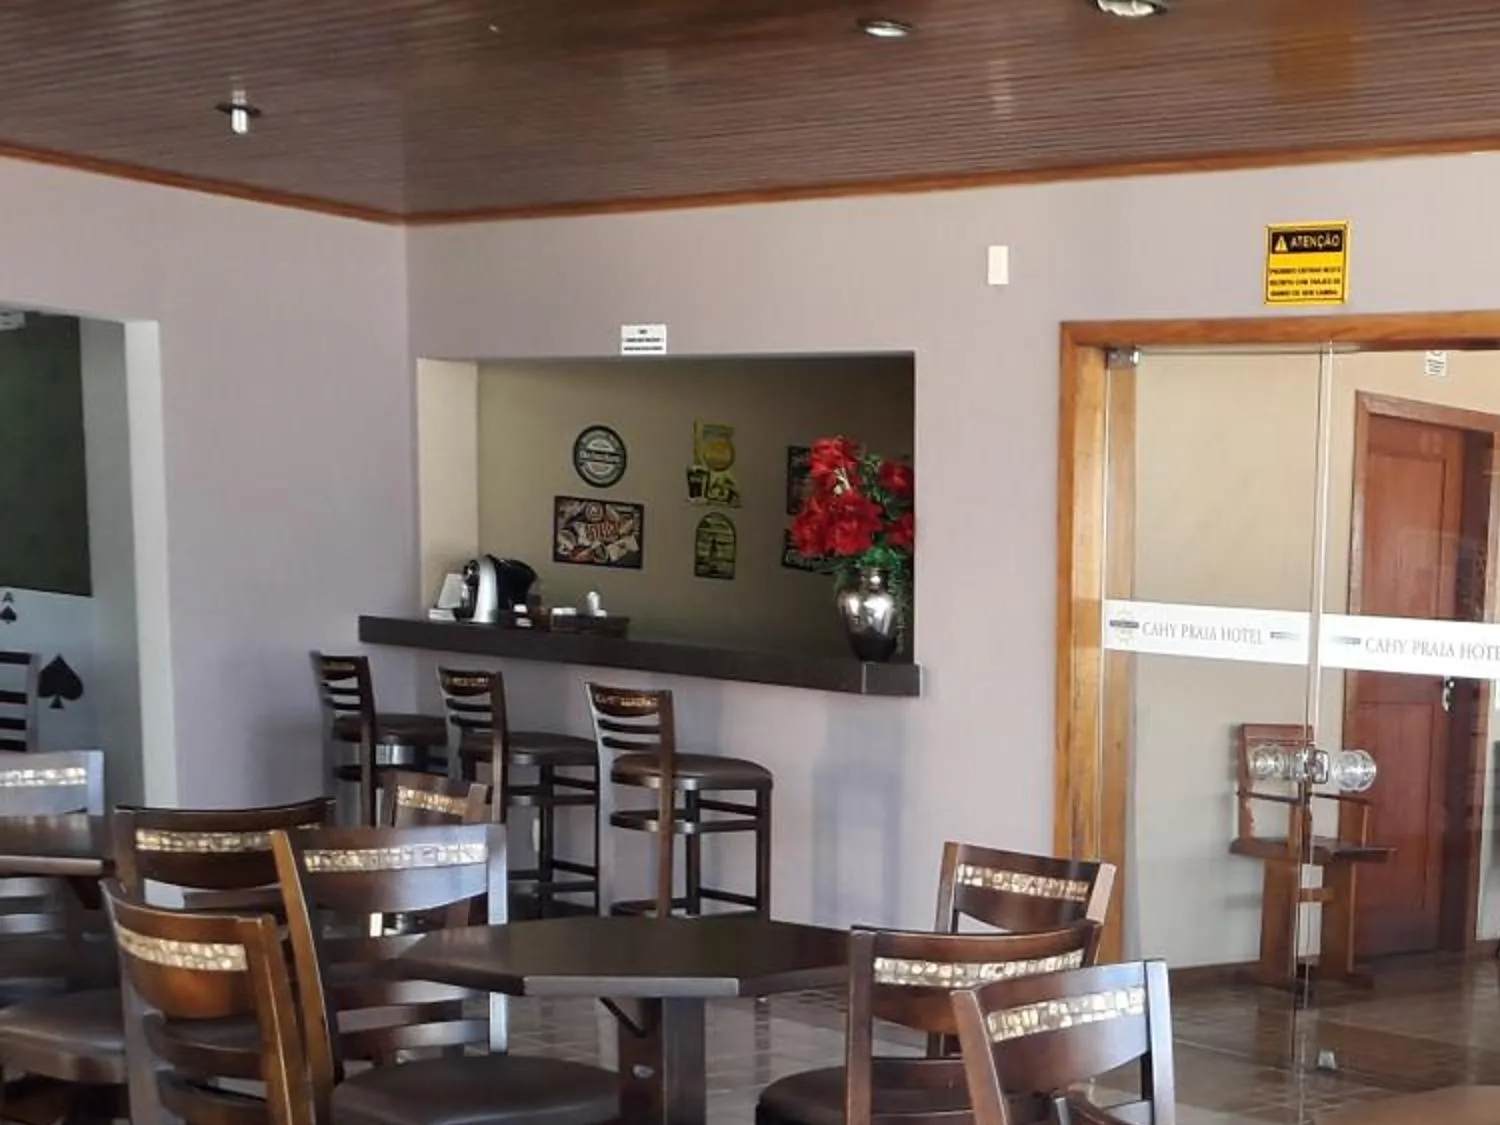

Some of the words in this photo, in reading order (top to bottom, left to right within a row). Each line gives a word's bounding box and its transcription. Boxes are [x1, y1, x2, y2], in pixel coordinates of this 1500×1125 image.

[1290, 233, 1340, 249] ATENÇÃO
[1142, 621, 1178, 638] CAHY
[1180, 623, 1218, 642] PRAIA
[1220, 627, 1265, 645] HOTEL
[1364, 636, 1408, 654] CAHY
[1411, 639, 1456, 658] PRAIA
